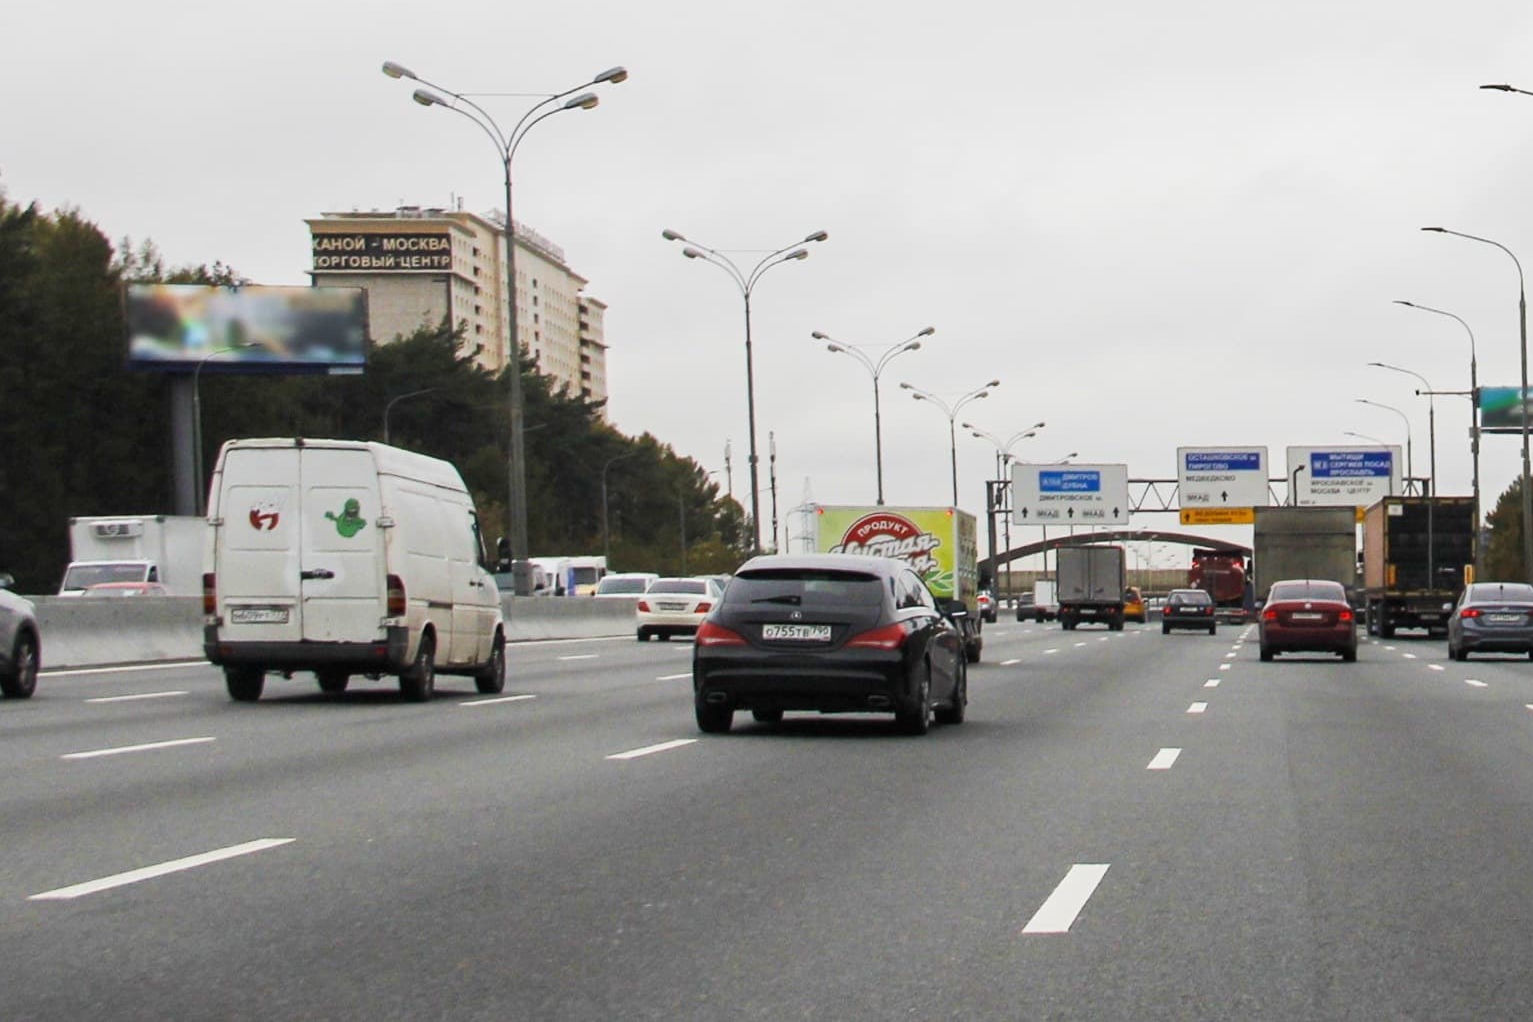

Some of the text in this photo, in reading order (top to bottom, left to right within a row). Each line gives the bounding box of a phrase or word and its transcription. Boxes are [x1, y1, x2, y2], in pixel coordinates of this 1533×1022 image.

[383, 237, 450, 251] МОСКВА
[400, 255, 450, 268] ЦЕНТР
[857, 520, 909, 538] ПРОДУКТ
